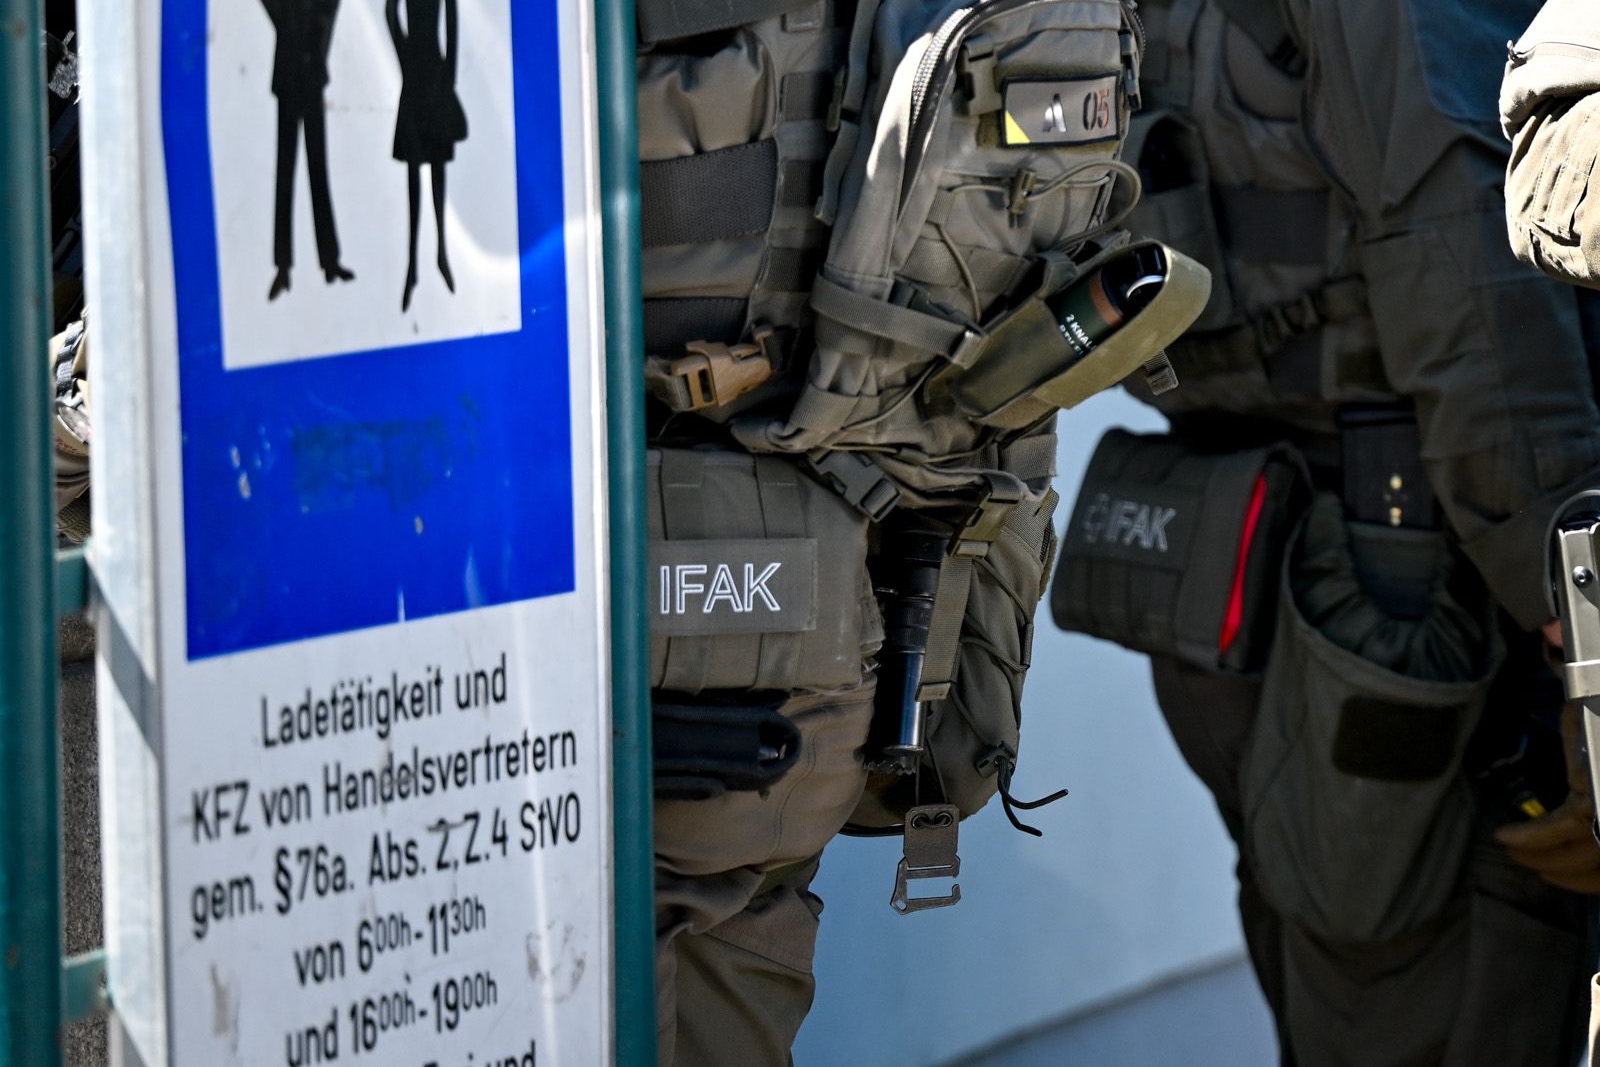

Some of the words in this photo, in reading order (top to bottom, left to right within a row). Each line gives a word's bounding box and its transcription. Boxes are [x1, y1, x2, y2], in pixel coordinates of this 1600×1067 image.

[660, 562, 782, 614] IFAK
[261, 665, 443, 750] Ladetätigkeit
[455, 651, 507, 711] und
[190, 780, 251, 844] KFZ
[260, 782, 312, 829] von
[323, 729, 578, 816] Handelsvertretern
[191, 874, 264, 941] gem.
[367, 831, 427, 887] Abs.
[518, 791, 582, 854] StVO
[294, 939, 345, 987] von
[285, 1007, 339, 1067] und
